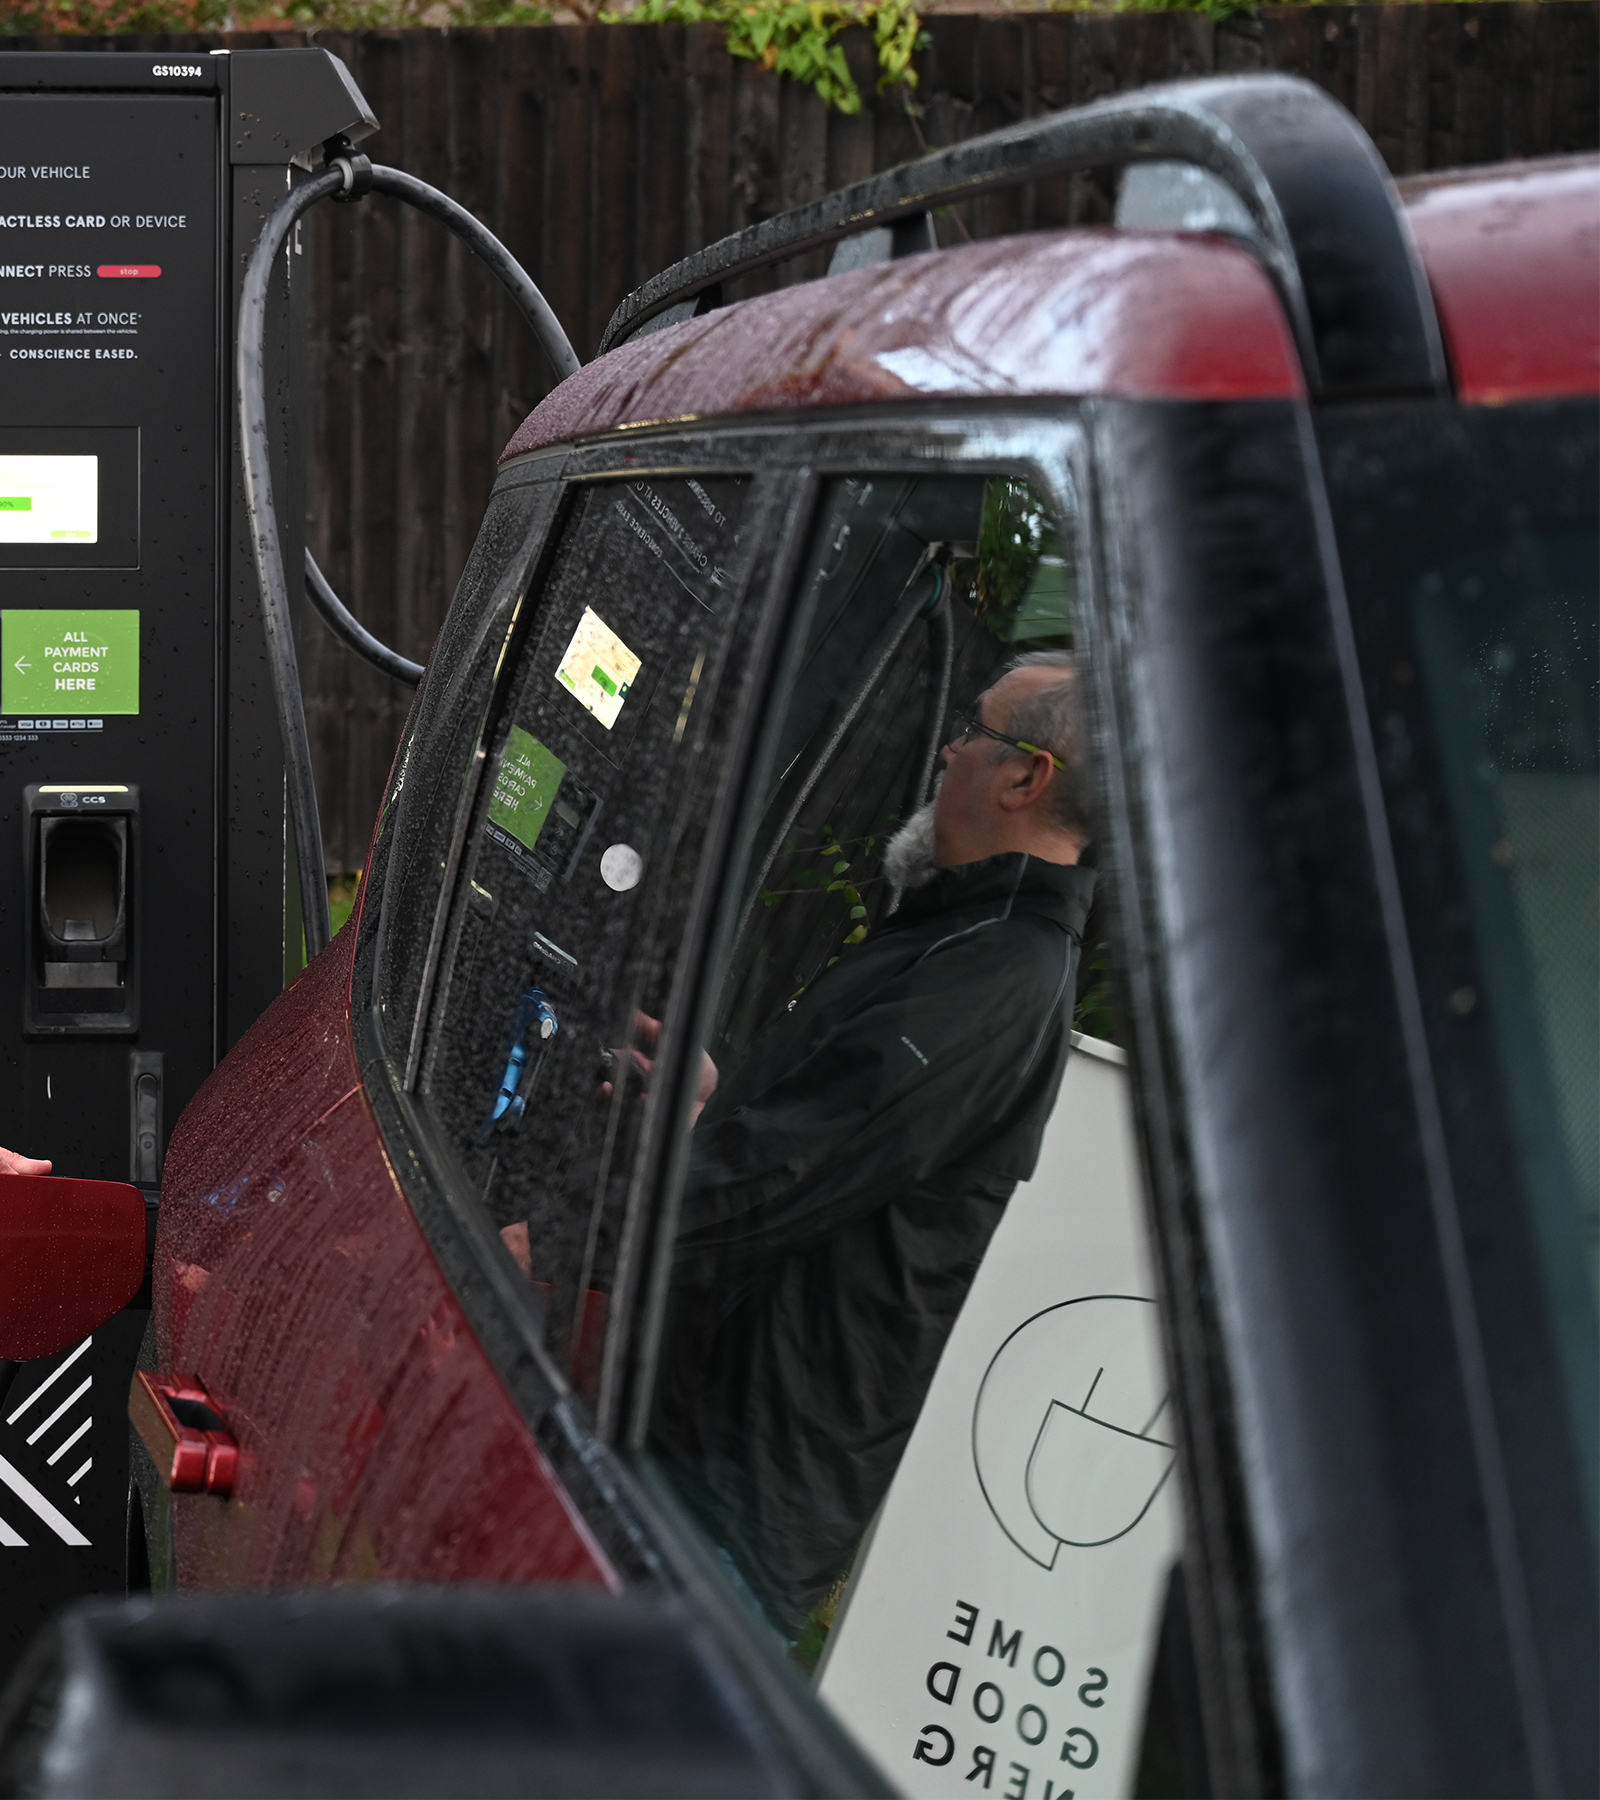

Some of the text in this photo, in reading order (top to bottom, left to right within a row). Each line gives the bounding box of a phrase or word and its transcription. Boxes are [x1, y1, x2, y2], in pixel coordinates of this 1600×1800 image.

[152, 65, 202, 77] GS10394
[31, 166, 91, 179] VEHICLE
[65, 215, 106, 228] CARD
[110, 215, 131, 228] OR
[135, 215, 187, 228] DEVICE
[48, 265, 92, 278] PRESS
[119, 268, 139, 276] stop
[0, 312, 73, 325] VEHICLES
[76, 312, 93, 325] AT
[9, 348, 138, 360] CONSCIENCE EASED.
[63, 631, 89, 643] ALL
[44, 646, 109, 658] PAYMENT
[53, 661, 100, 673] CARDS
[55, 678, 96, 691] HERE
[82, 796, 106, 804] CCS
